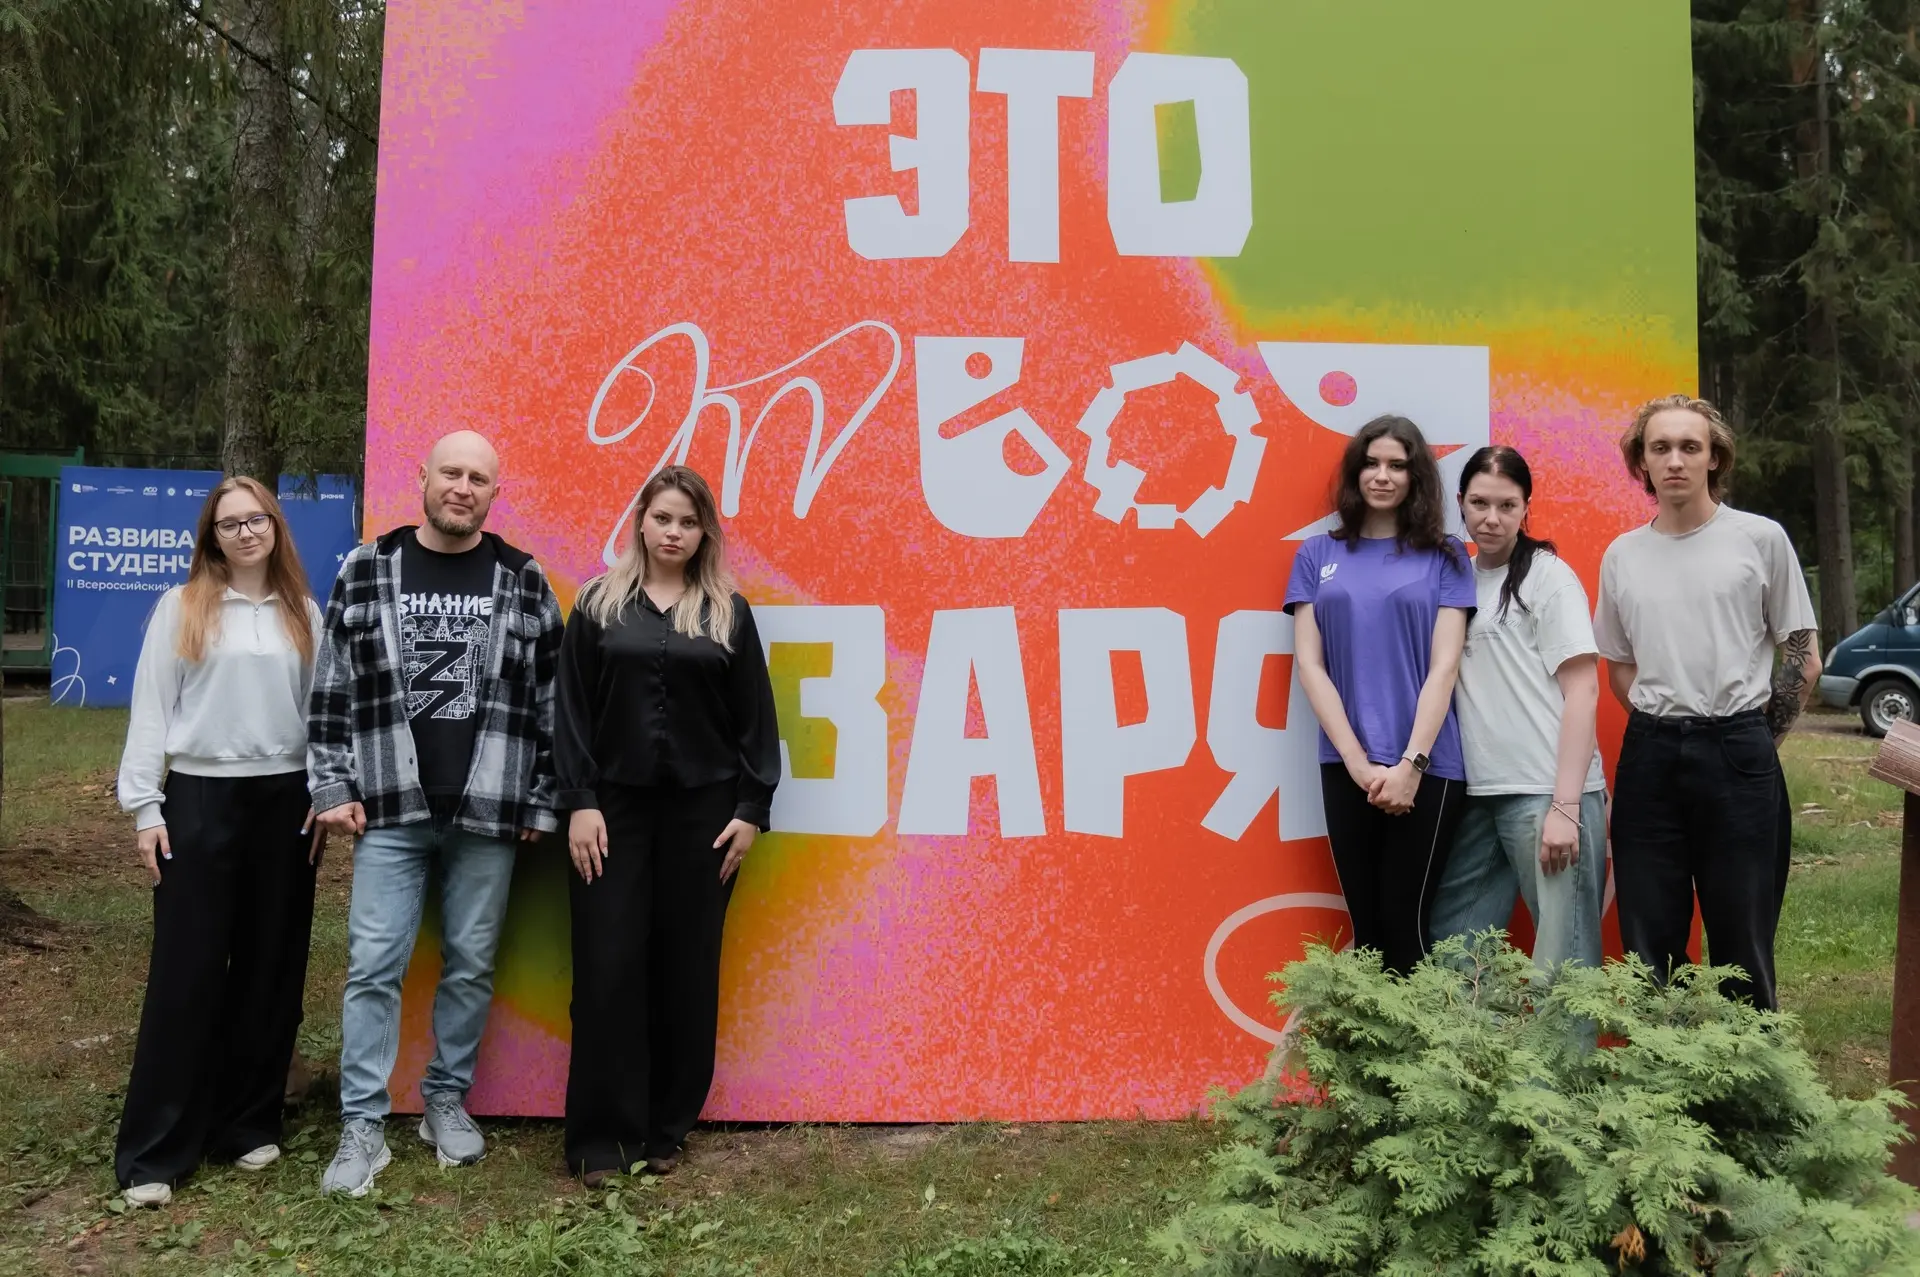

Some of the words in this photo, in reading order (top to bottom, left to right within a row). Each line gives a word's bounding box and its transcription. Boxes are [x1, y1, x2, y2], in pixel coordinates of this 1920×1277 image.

[832, 48, 1253, 263] ЭТО
[69, 526, 195, 548] РАЗВИВА
[67, 551, 192, 576] СТУДЕНЧ
[77, 579, 170, 591] Всероссийский
[752, 604, 1328, 842] ЗАРЯ
